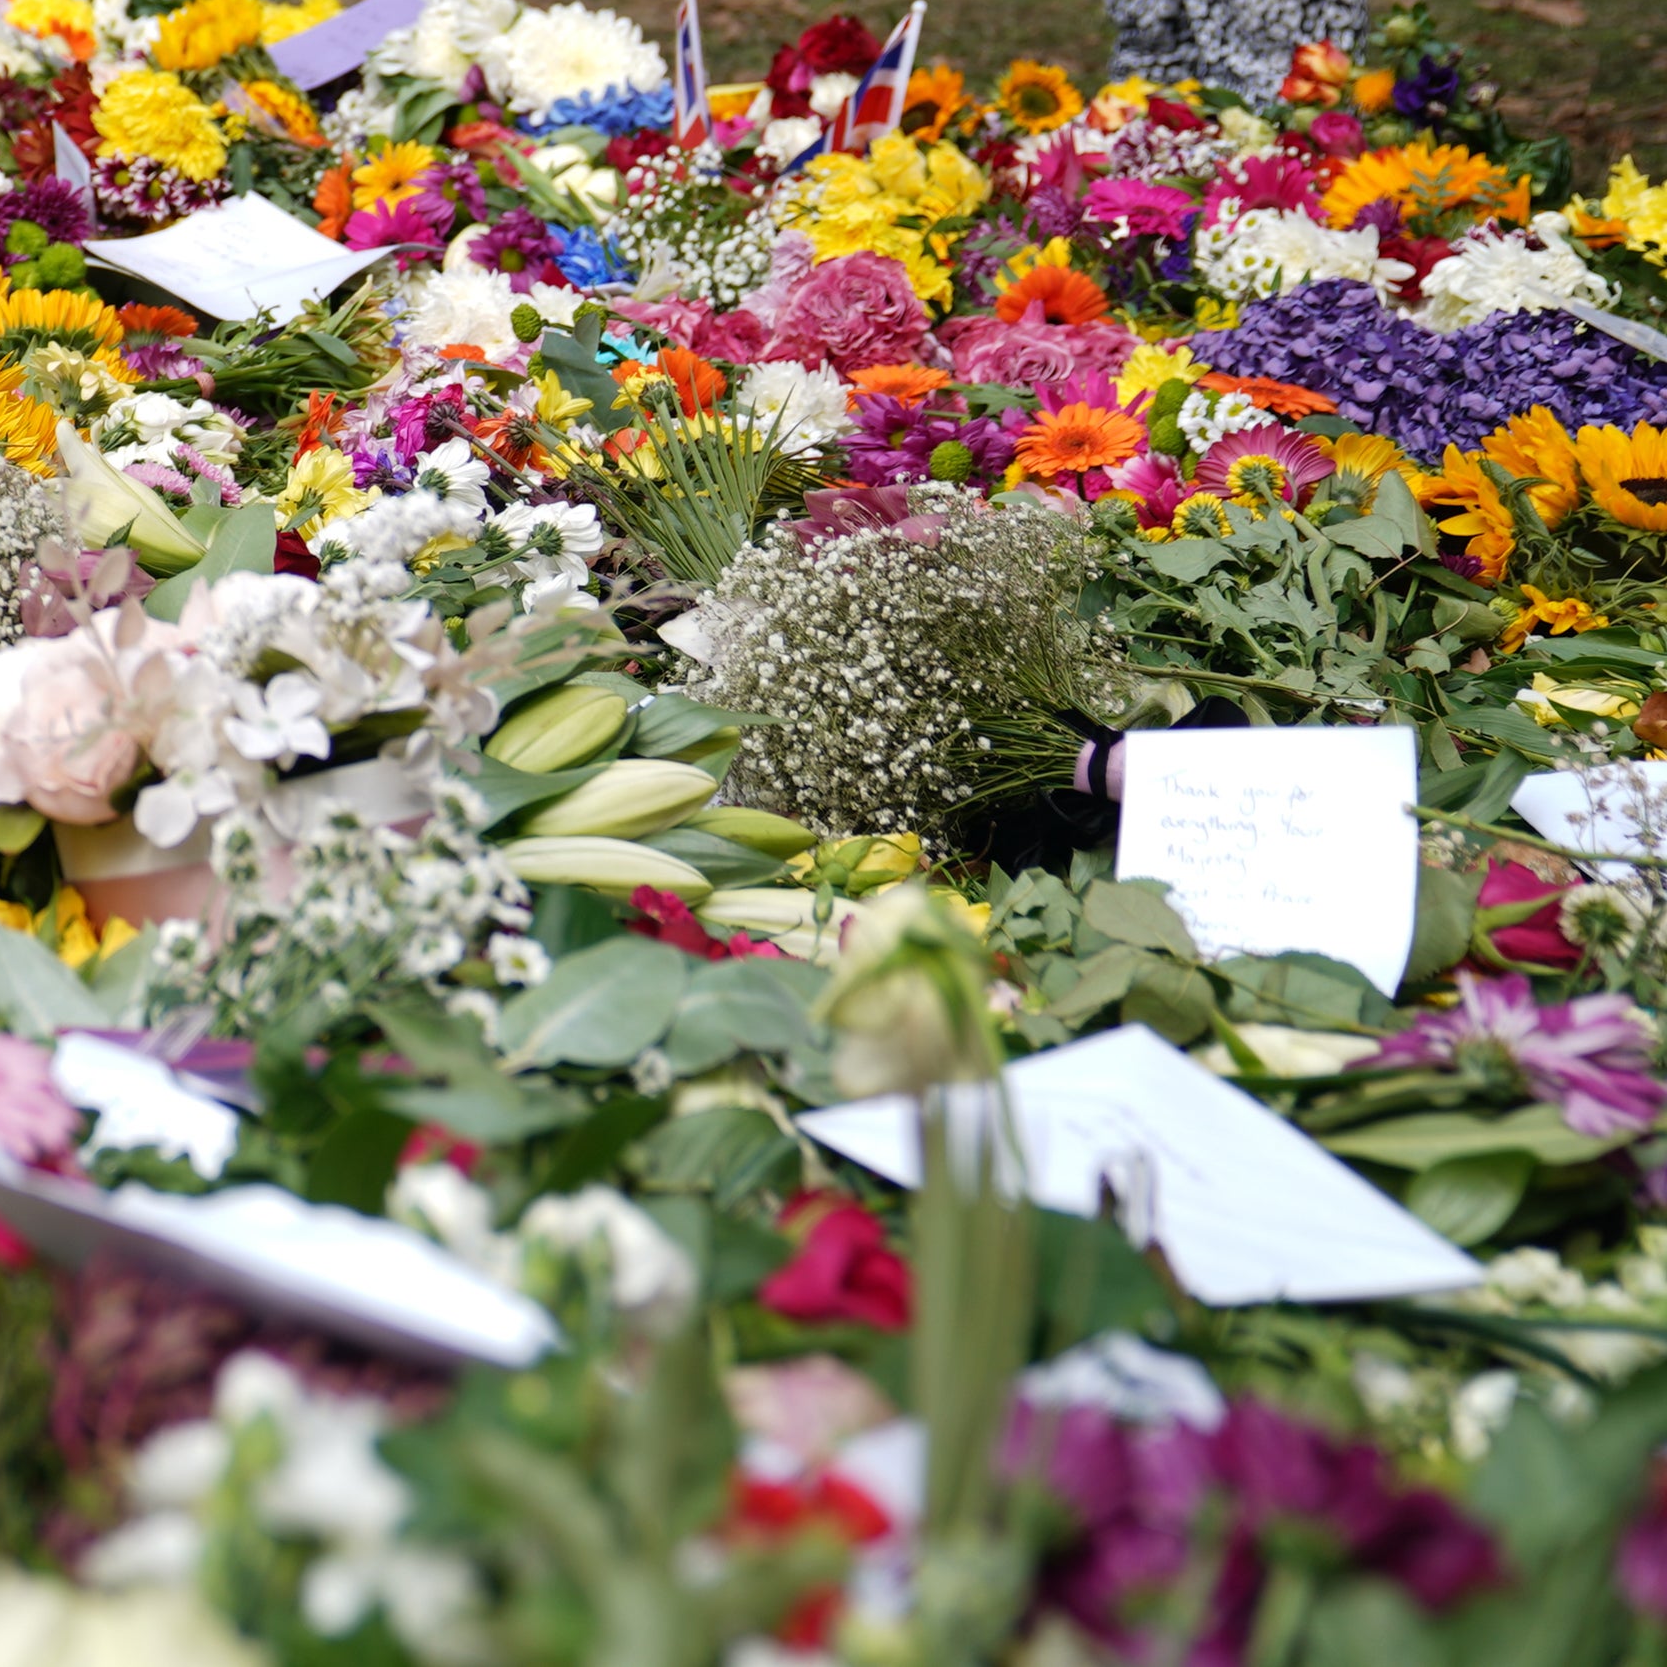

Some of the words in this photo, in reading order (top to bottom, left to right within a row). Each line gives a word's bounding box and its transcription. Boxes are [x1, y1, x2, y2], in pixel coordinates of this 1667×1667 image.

[1153, 769, 1220, 800] Thank
[1238, 787, 1279, 817] you
[1166, 843, 1249, 885] Majesty
